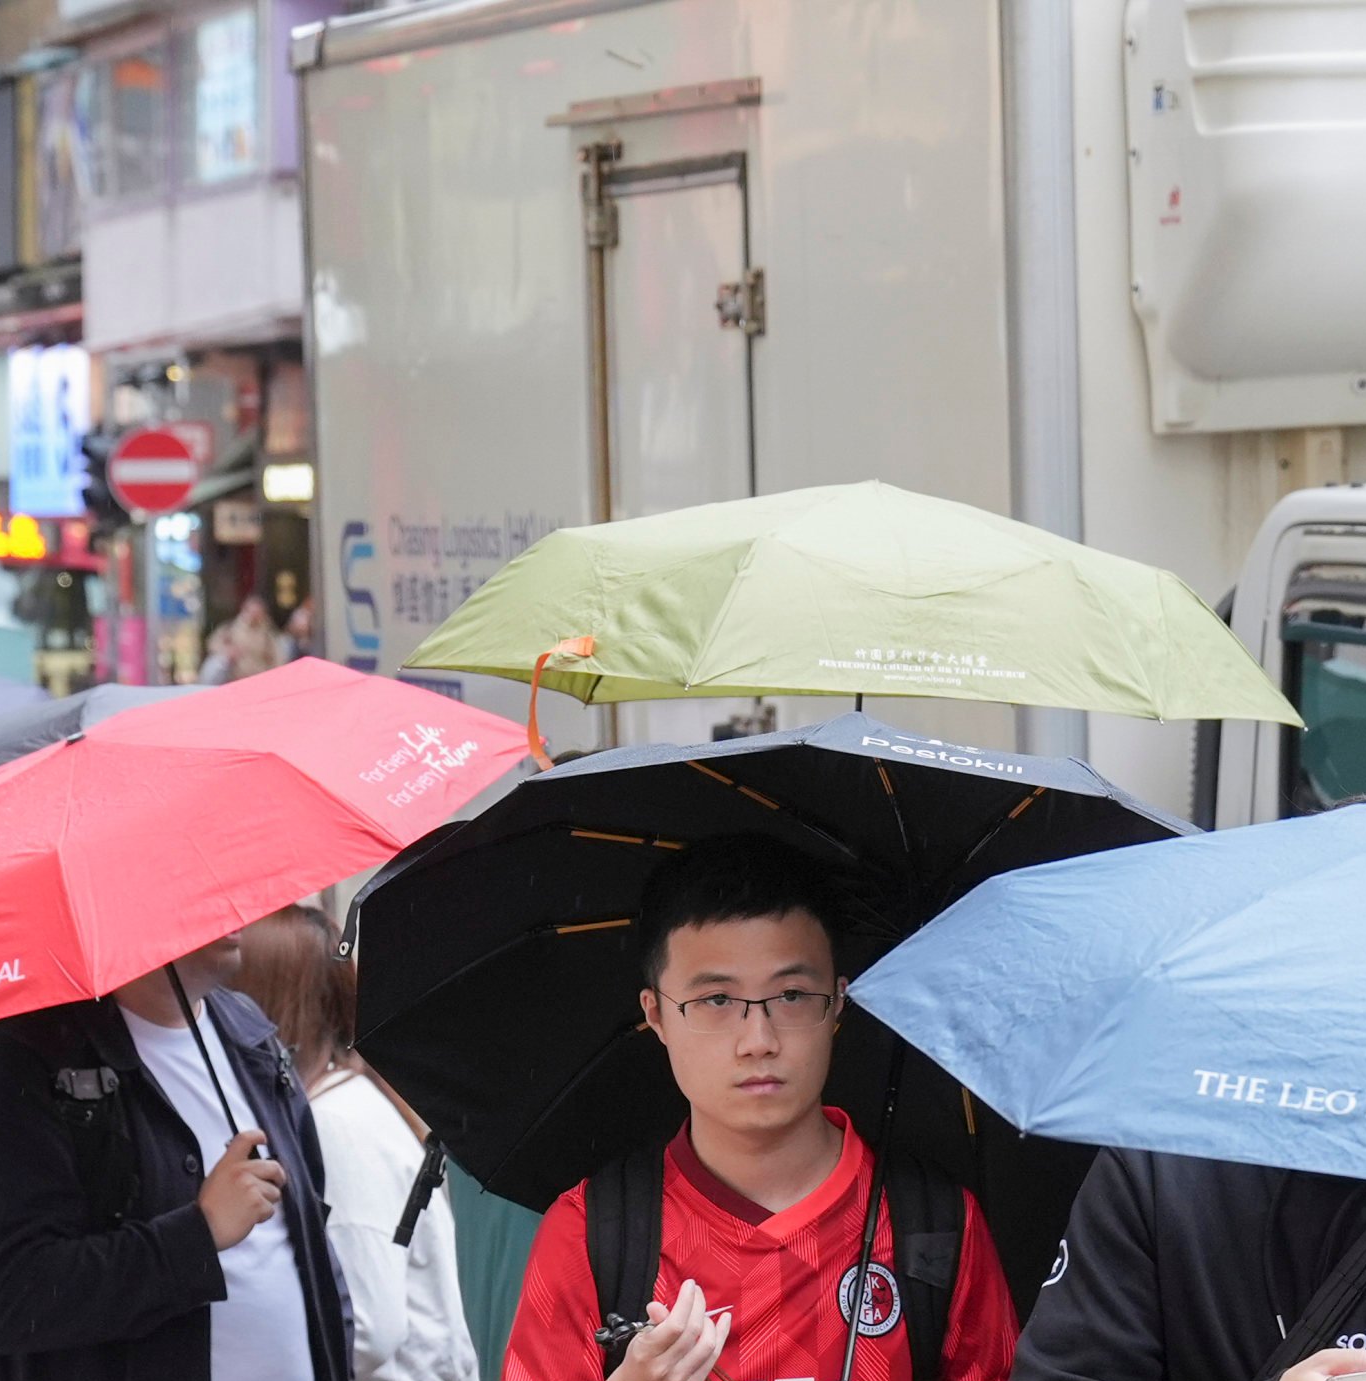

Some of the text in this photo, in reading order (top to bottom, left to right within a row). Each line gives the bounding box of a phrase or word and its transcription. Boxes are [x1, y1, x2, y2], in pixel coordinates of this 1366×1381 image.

[818, 658, 882, 670] PENTECOSTAL
[883, 663, 922, 673] CHURCH
[954, 666, 970, 676] TAI
[972, 668, 985, 677] PO
[986, 669, 1026, 679] CHURCH
[358, 770, 386, 785] For
[376, 746, 417, 774] Every
[387, 739, 479, 808] For Every Future
[1193, 1068, 1269, 1104] THE
[1278, 1081, 1358, 1116] LEO
[863, 1307, 883, 1321] FA
